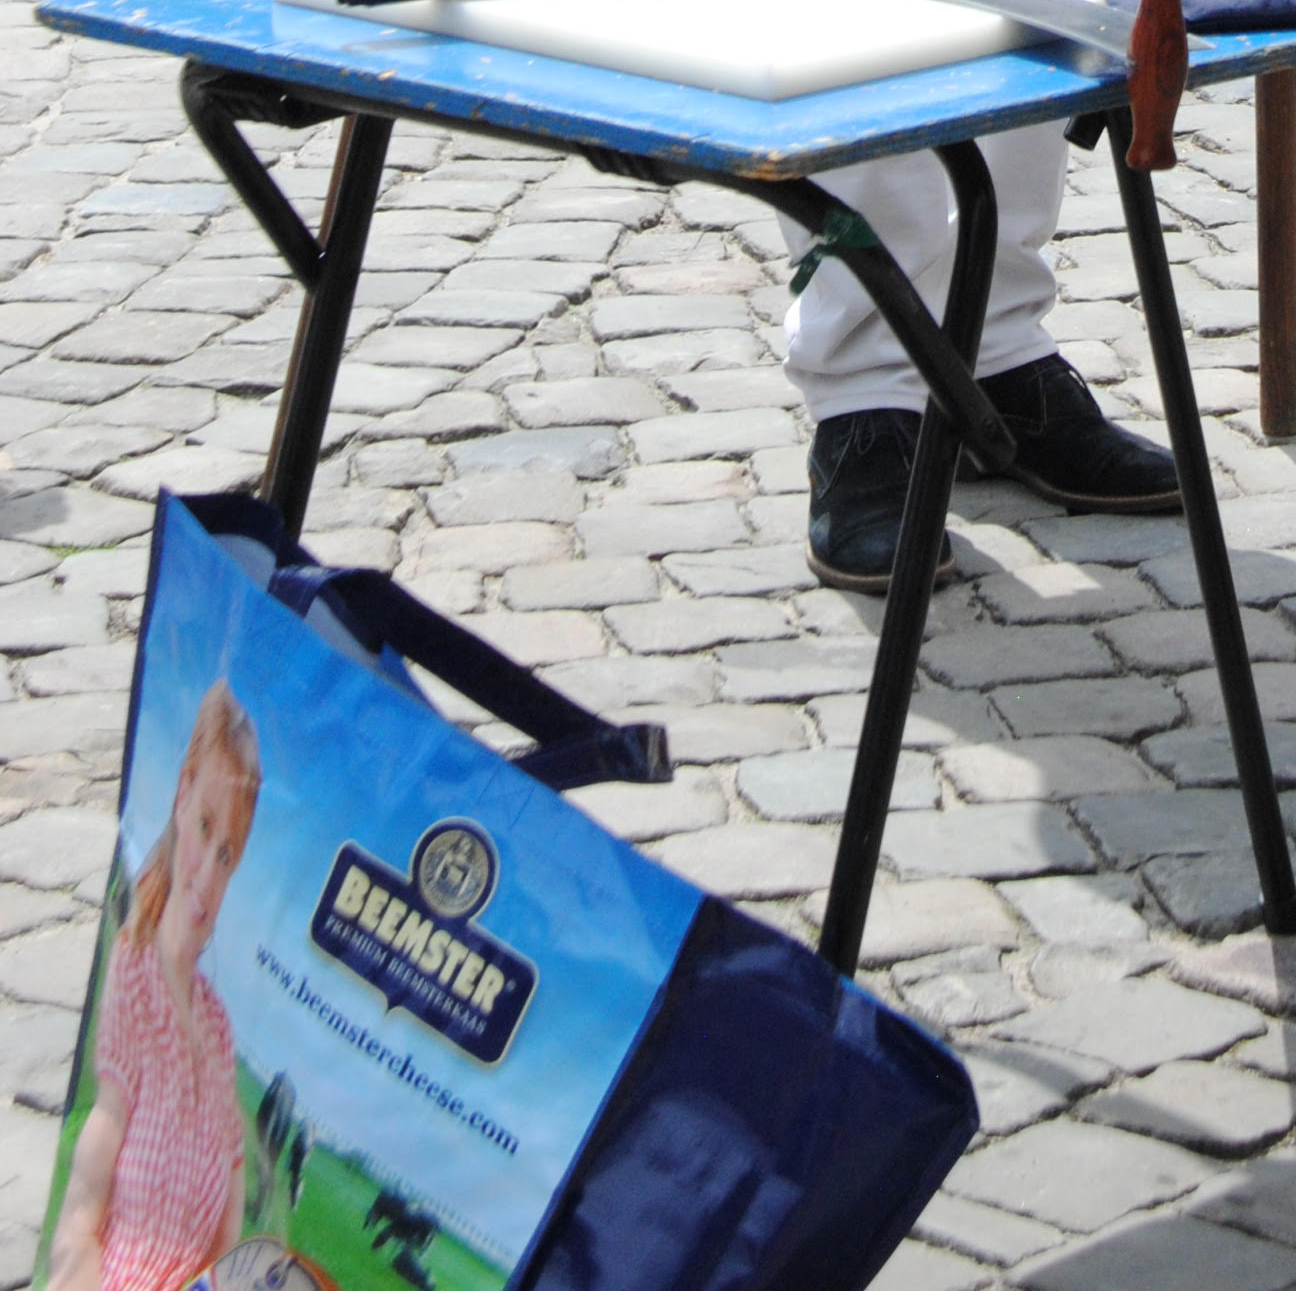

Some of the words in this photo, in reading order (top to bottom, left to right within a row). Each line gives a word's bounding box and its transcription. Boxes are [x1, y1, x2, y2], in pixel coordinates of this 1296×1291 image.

[324, 914, 388, 965] PREMIUM
[333, 863, 506, 1016] BEEMSTER
[256, 940, 521, 1158] www.beemstercheese.com
